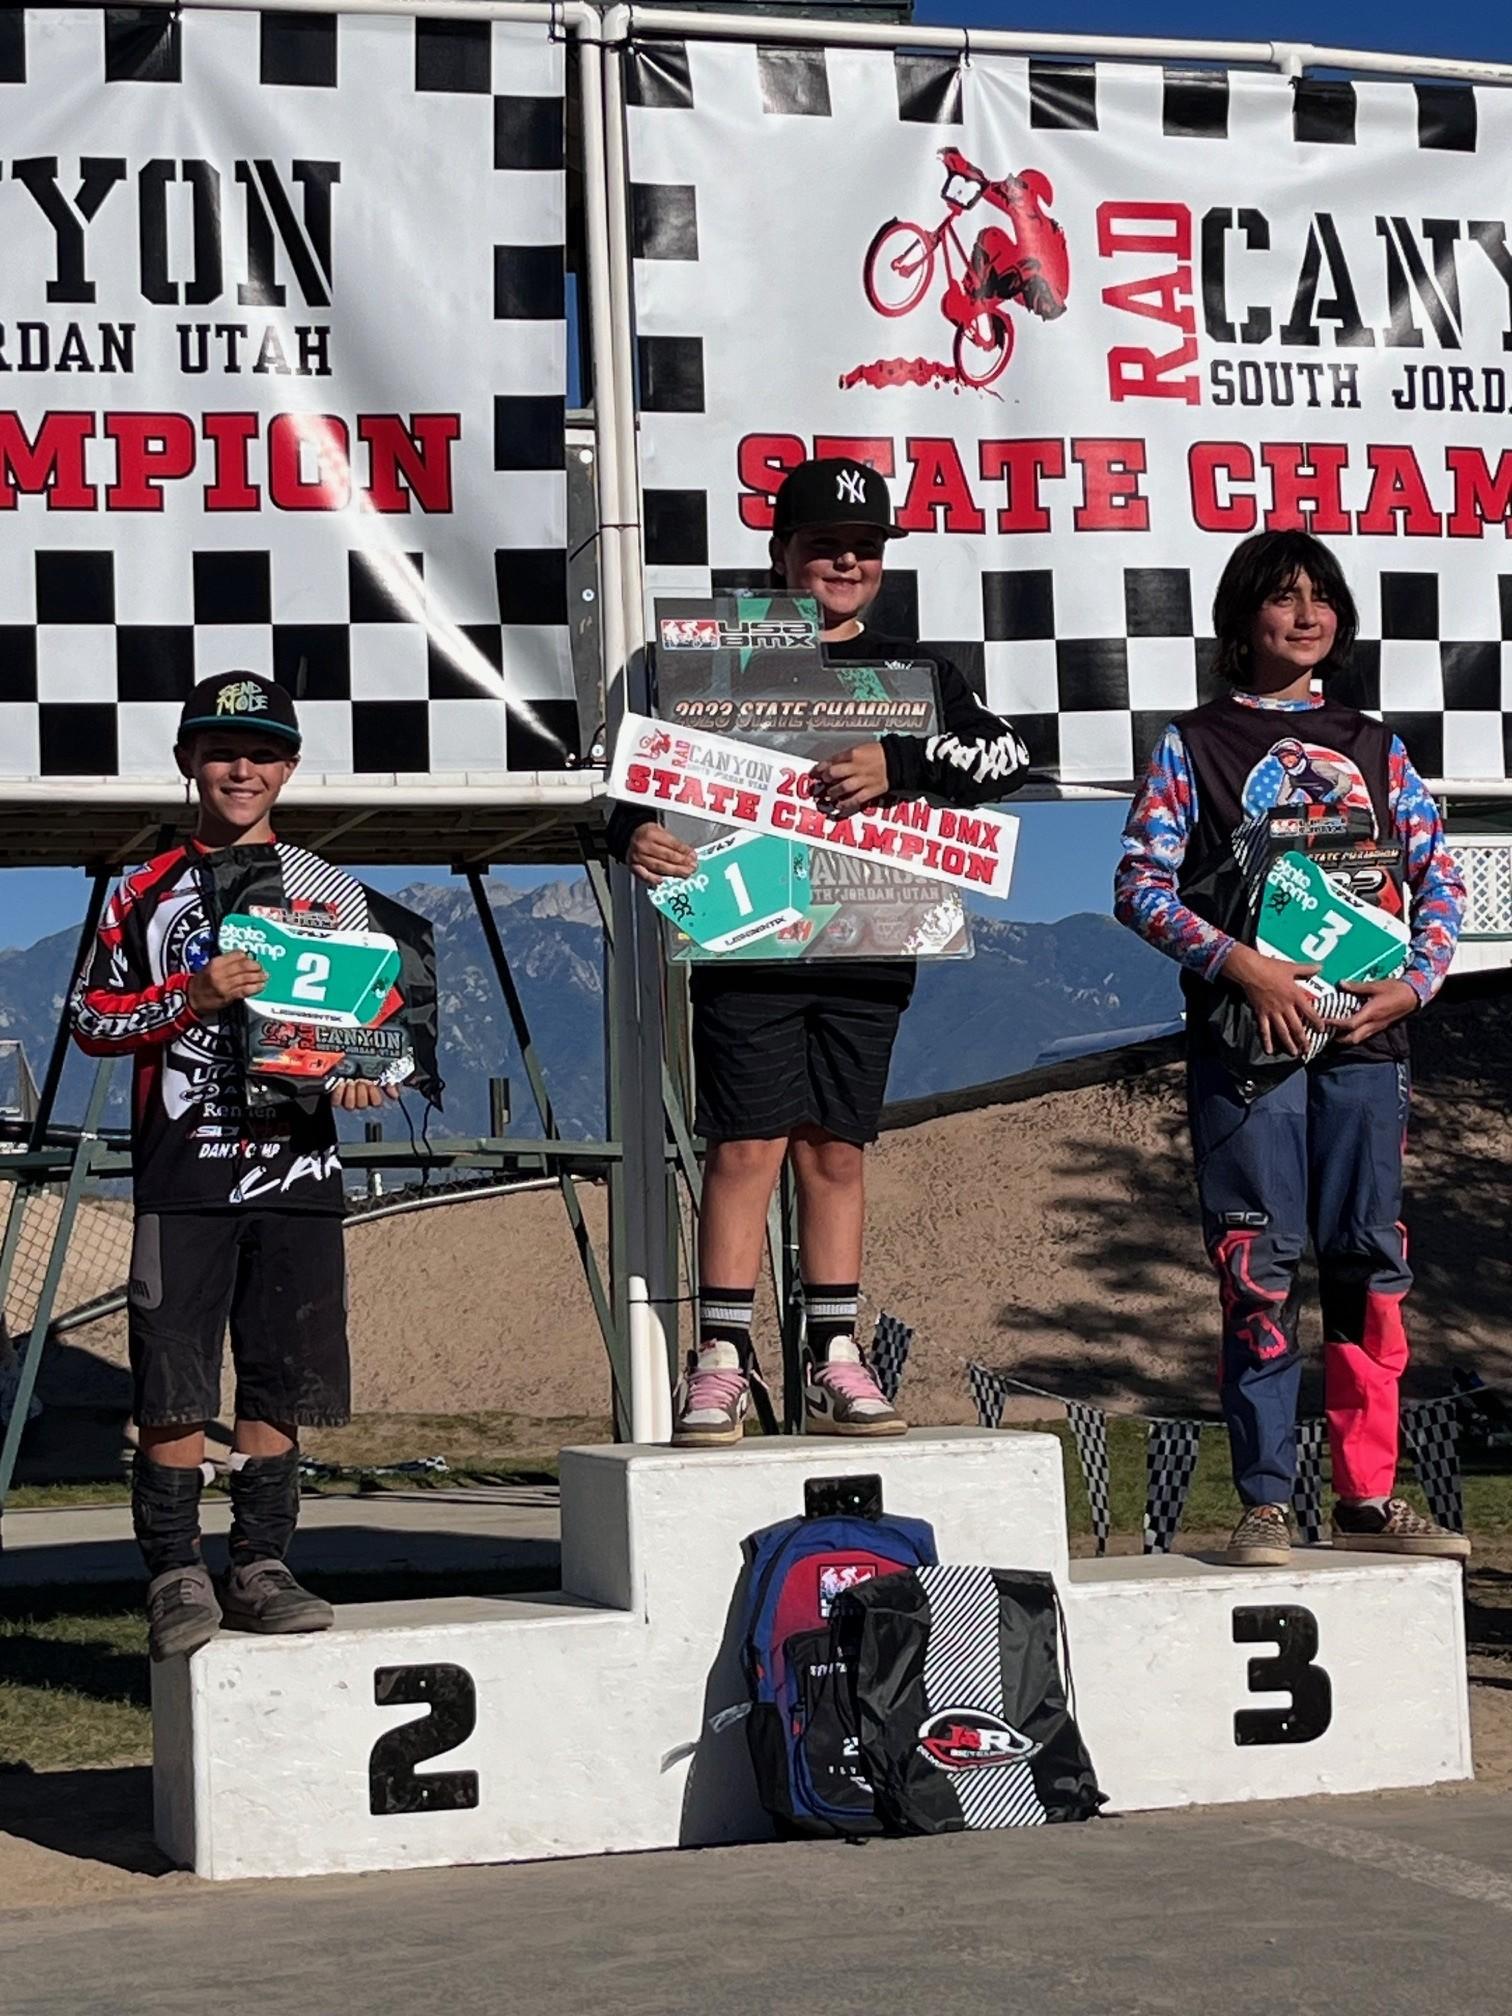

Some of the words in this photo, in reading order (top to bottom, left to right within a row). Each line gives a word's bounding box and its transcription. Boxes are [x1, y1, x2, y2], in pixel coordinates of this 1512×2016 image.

[0, 156, 341, 307] YON
[1096, 201, 1201, 406] RAD
[177, 323, 333, 376] UTAH
[1209, 358, 1362, 409] SOUTH
[1391, 364, 1512, 414] JORD
[836, 469, 867, 504] NY
[216, 694, 269, 717] MODE
[218, 680, 262, 699] SEND
[736, 701, 804, 728] STATE
[811, 701, 928, 728] CHAMPION
[689, 744, 774, 783] CANYON
[624, 762, 763, 823] STATE
[770, 800, 999, 886] CHAMPION
[938, 808, 1002, 854] BMX
[723, 861, 754, 917] 1
[902, 887, 940, 901] UTAH
[1300, 909, 1353, 962] 3
[291, 951, 331, 1002] 2
[315, 1025, 401, 1050] CANYON
[1232, 1604, 1333, 1746] 3
[368, 1662, 480, 1816] 2
